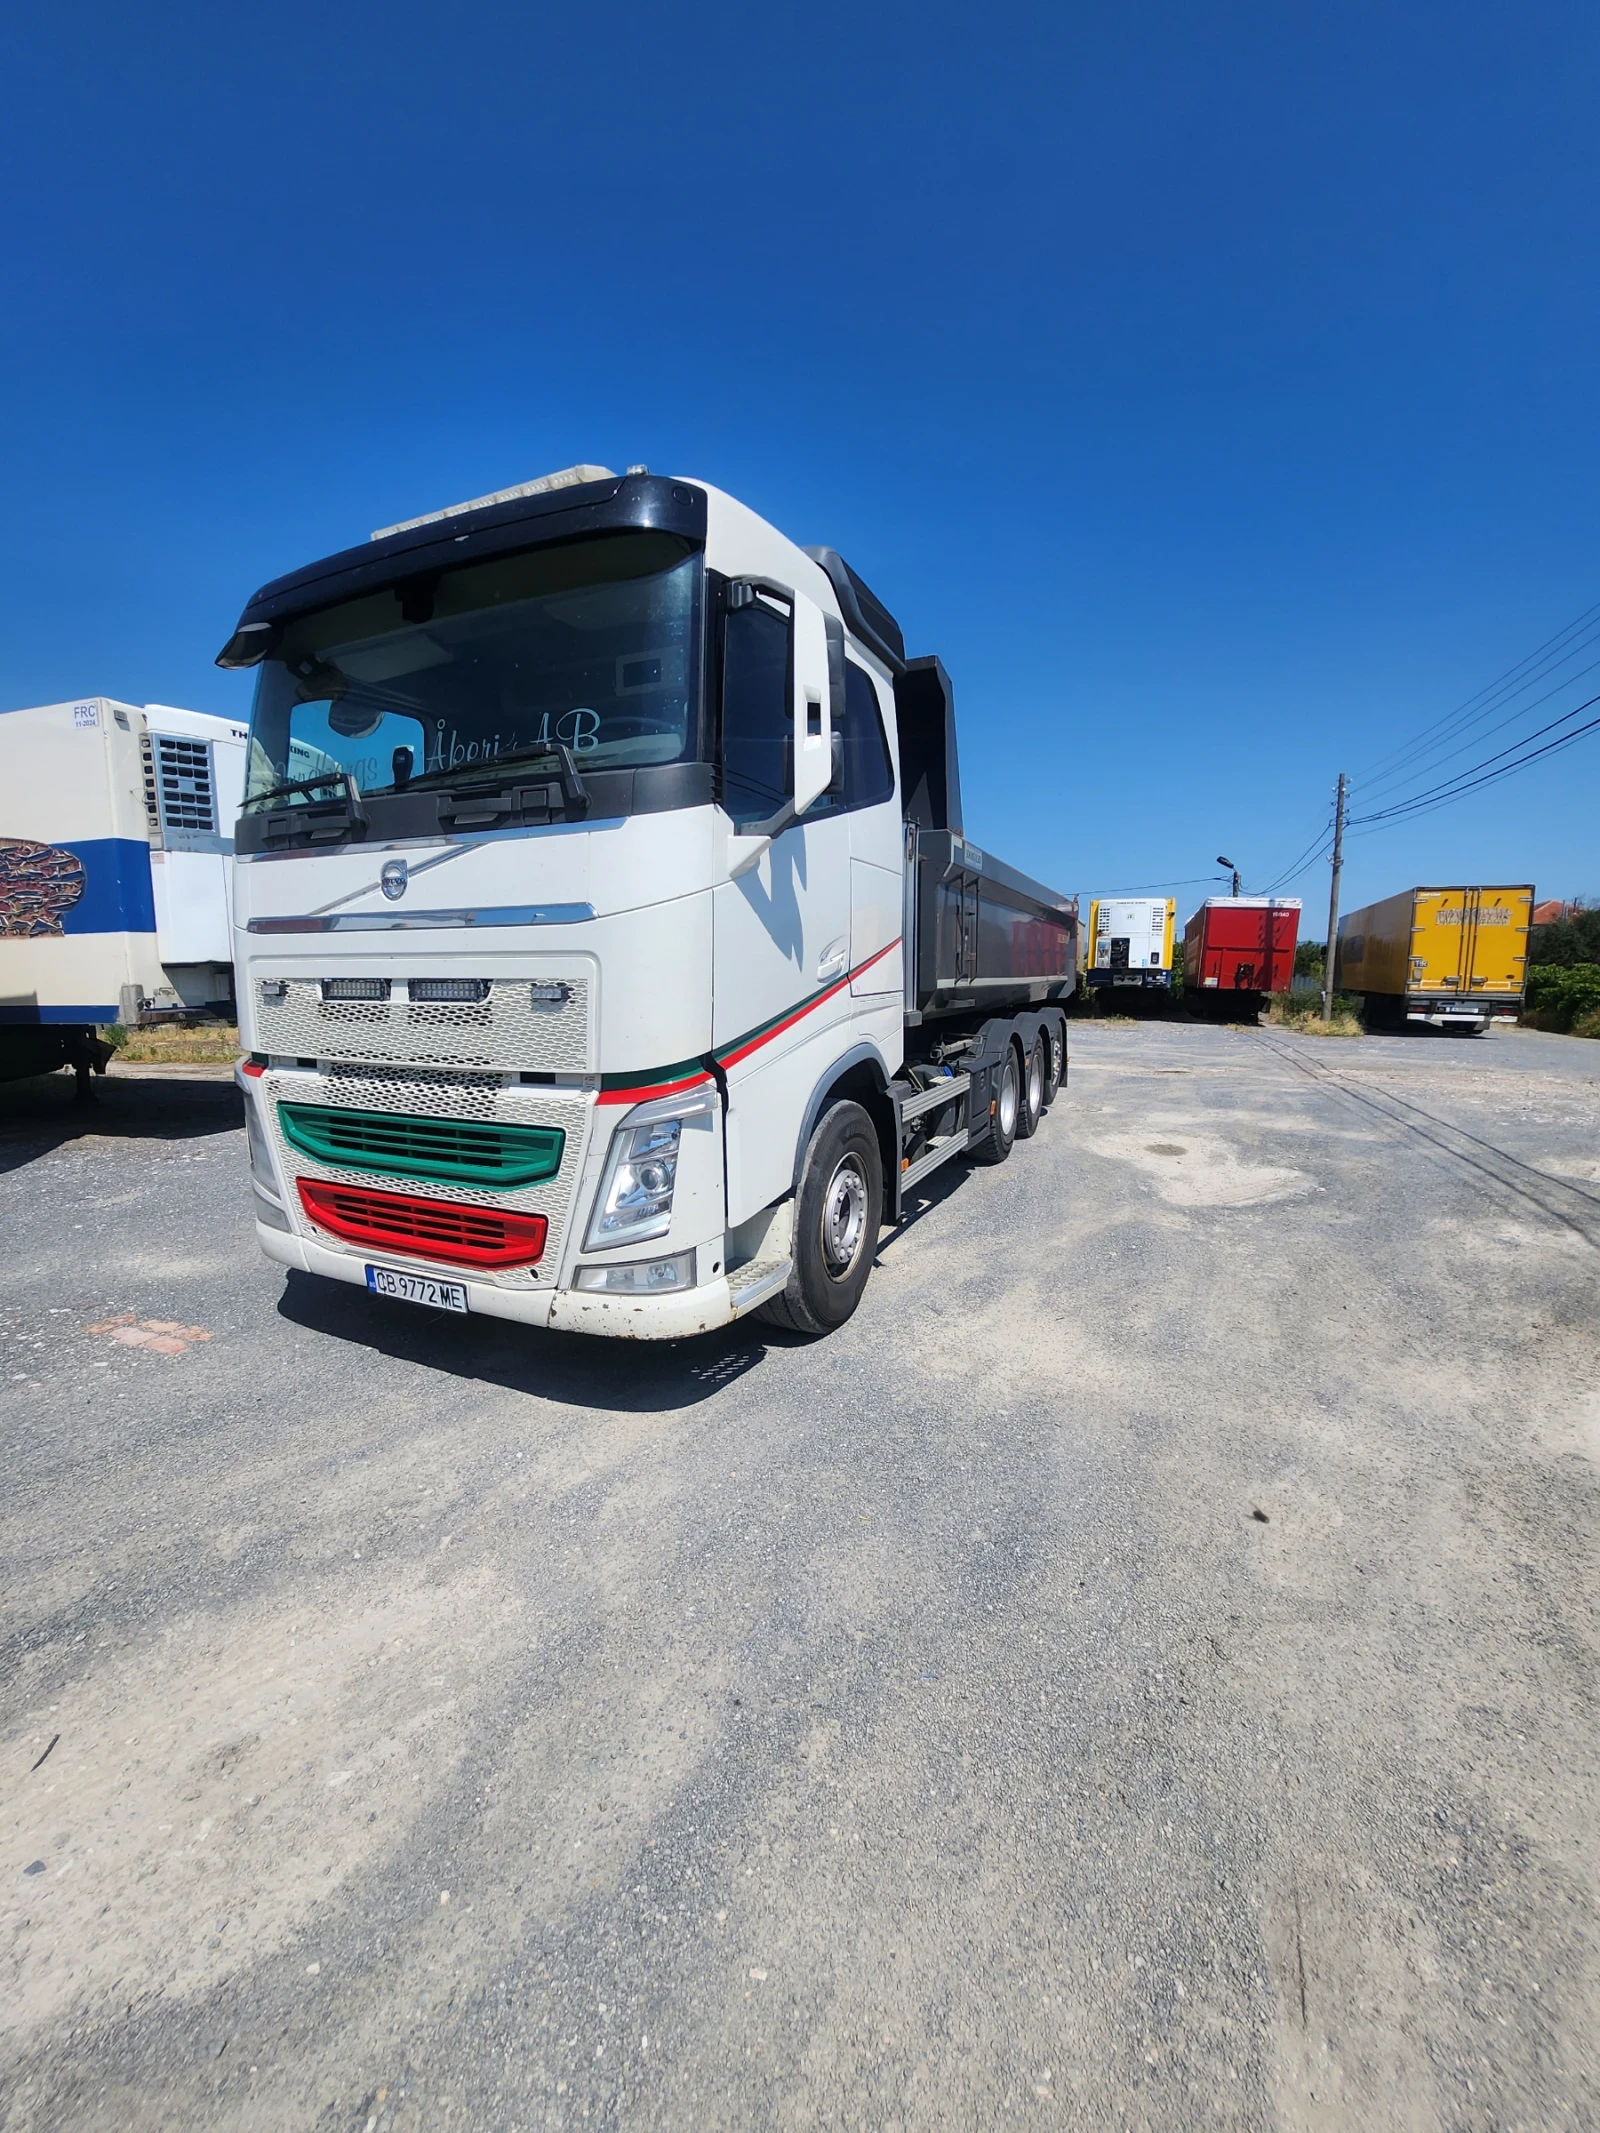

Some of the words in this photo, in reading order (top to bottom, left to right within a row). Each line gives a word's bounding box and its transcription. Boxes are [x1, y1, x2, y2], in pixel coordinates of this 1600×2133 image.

[74, 705, 96, 719] FRC
[230, 728, 248, 740] TH
[398, 1277, 438, 1304] 9772
[439, 1284, 463, 1309] ME
